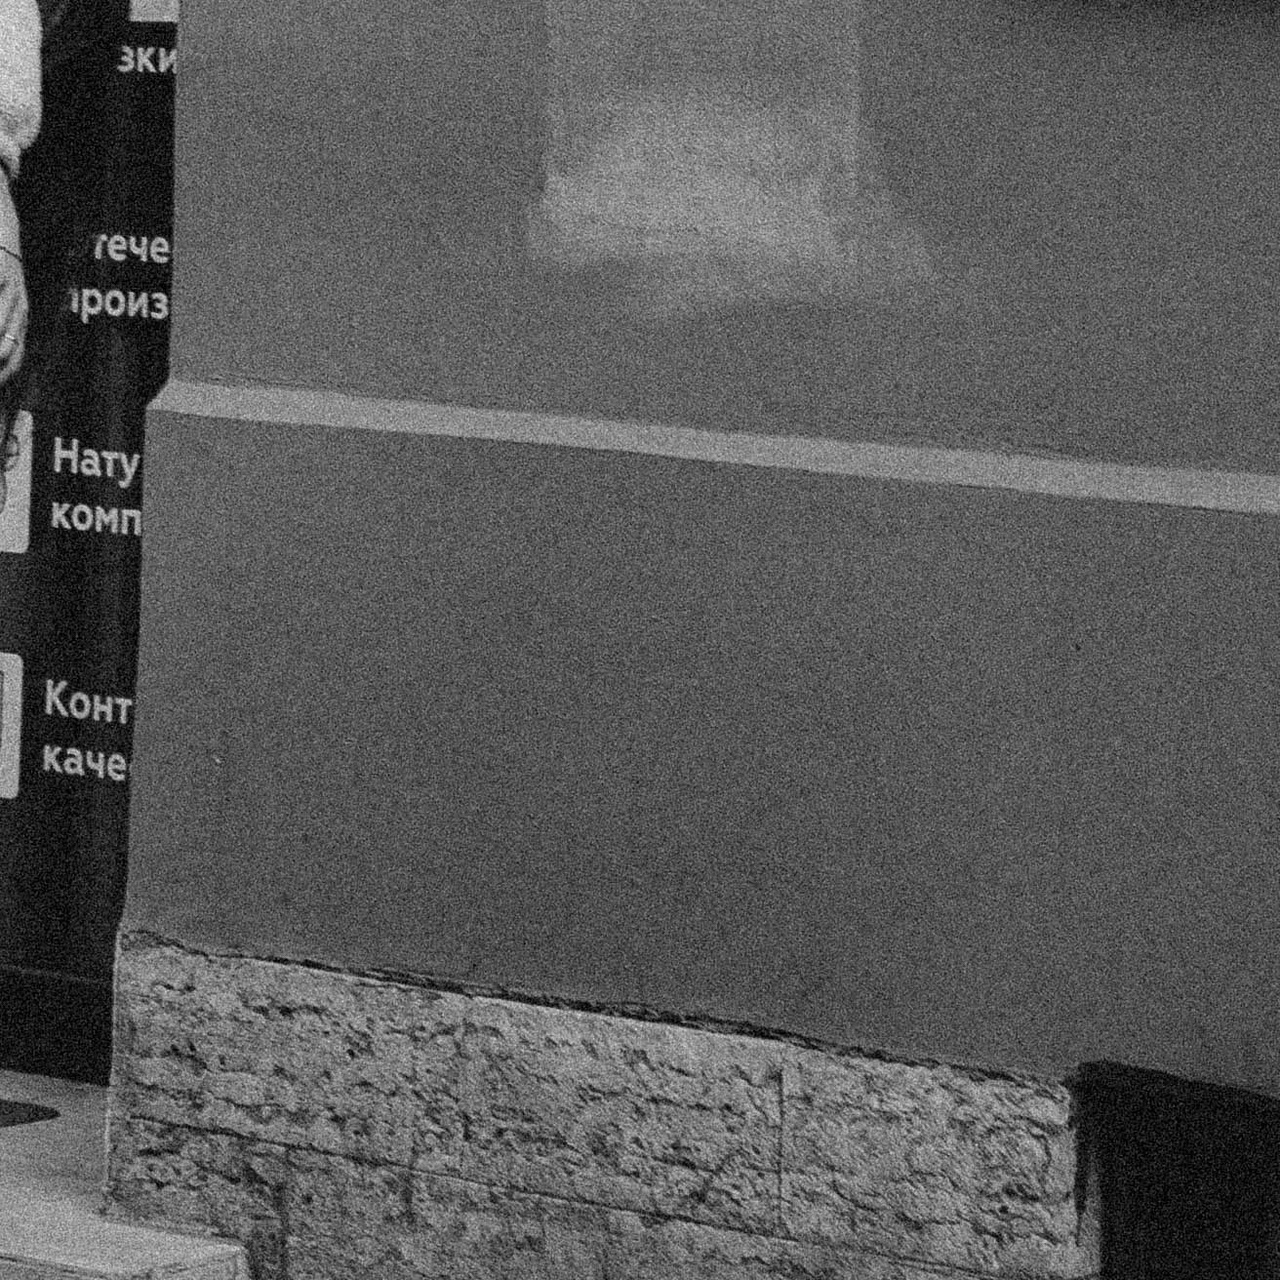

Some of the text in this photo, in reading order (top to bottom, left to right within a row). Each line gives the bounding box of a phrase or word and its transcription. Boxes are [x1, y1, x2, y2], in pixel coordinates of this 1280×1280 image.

[53, 436, 141, 489] Нату
[51, 502, 143, 536] комп
[45, 678, 133, 725] Конт
[43, 744, 127, 782] каче
